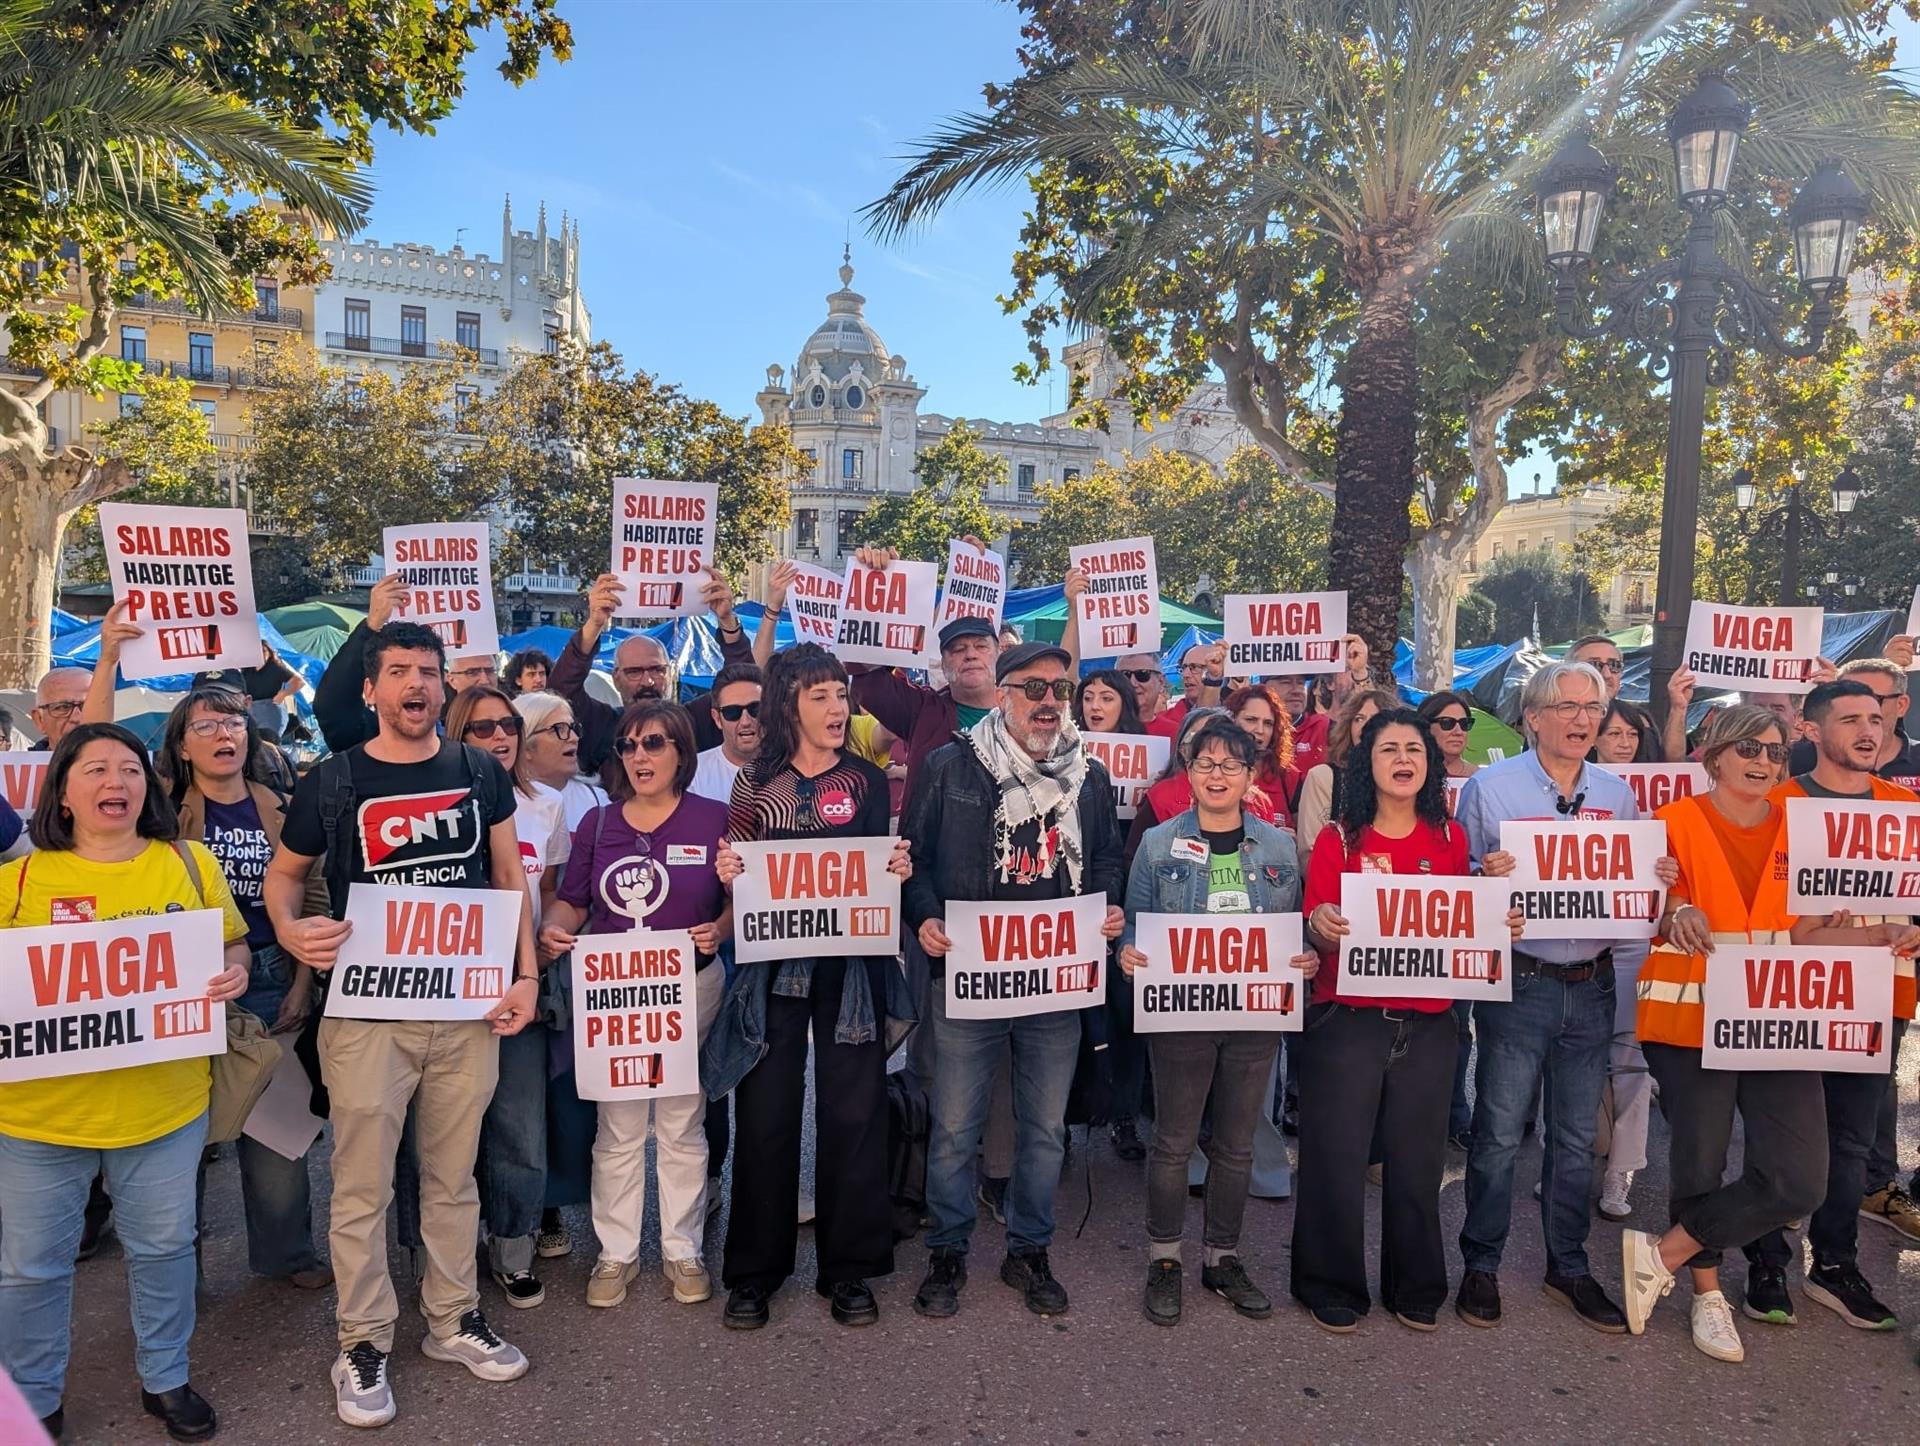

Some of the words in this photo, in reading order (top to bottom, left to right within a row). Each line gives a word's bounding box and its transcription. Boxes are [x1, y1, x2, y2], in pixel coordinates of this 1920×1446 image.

[624, 494, 705, 521] SALARIS
[117, 525, 231, 557] SALARIS
[395, 537, 478, 563] SALARIS
[623, 524, 704, 545] HABITATGE
[123, 562, 234, 586] HABITATGE
[622, 547, 701, 574] PREUS
[955, 553, 1000, 584] SALARIS
[1080, 550, 1146, 576] SALARIS
[397, 567, 479, 586] HABITATGE
[794, 574, 843, 600] SALA
[845, 569, 906, 614] AGA
[950, 579, 999, 604] HABITATGE
[127, 590, 239, 622] PREUS
[398, 589, 481, 617] PREUS
[796, 599, 838, 620] HABITA
[1085, 593, 1150, 620] PREUS
[799, 616, 834, 639] PRE
[838, 619, 883, 647] ERAL
[1248, 602, 1322, 636] VAGA
[1713, 613, 1792, 652] VAGA
[1230, 642, 1303, 663] GENERAL
[1689, 651, 1769, 679] GENERAL
[1087, 742, 1148, 779] AGA
[1620, 773, 1693, 813] AGA
[380, 808, 462, 848] CNT
[1824, 812, 1920, 862] VAGA
[1534, 834, 1634, 881] VAGA
[374, 865, 467, 886] VALÈNCIA
[767, 850, 868, 900] VAGA
[1797, 868, 1894, 898] GENERAL
[1376, 888, 1475, 939] VAGA
[1510, 891, 1610, 919] GENERAL
[386, 900, 484, 956] VAGA
[743, 908, 843, 942] GENERAL
[855, 909, 886, 935] 11N
[979, 911, 1077, 962] VAGA
[584, 948, 682, 982] SALARIS
[1168, 927, 1268, 974] VAGA
[1349, 947, 1448, 978] GENERAL
[27, 931, 178, 1007] VAGA
[341, 965, 456, 1000] GENERAL
[468, 968, 499, 997] 11N
[954, 968, 1053, 1000] GENERAL
[586, 983, 682, 1011] HABITATGE
[1143, 983, 1242, 1012] GENERAL
[1744, 959, 1854, 1011] VAGA
[0, 1007, 144, 1060] GENERAL
[160, 1000, 205, 1035] 11N
[587, 1010, 682, 1048] PREUS
[1714, 1019, 1823, 1050] GENERAL
